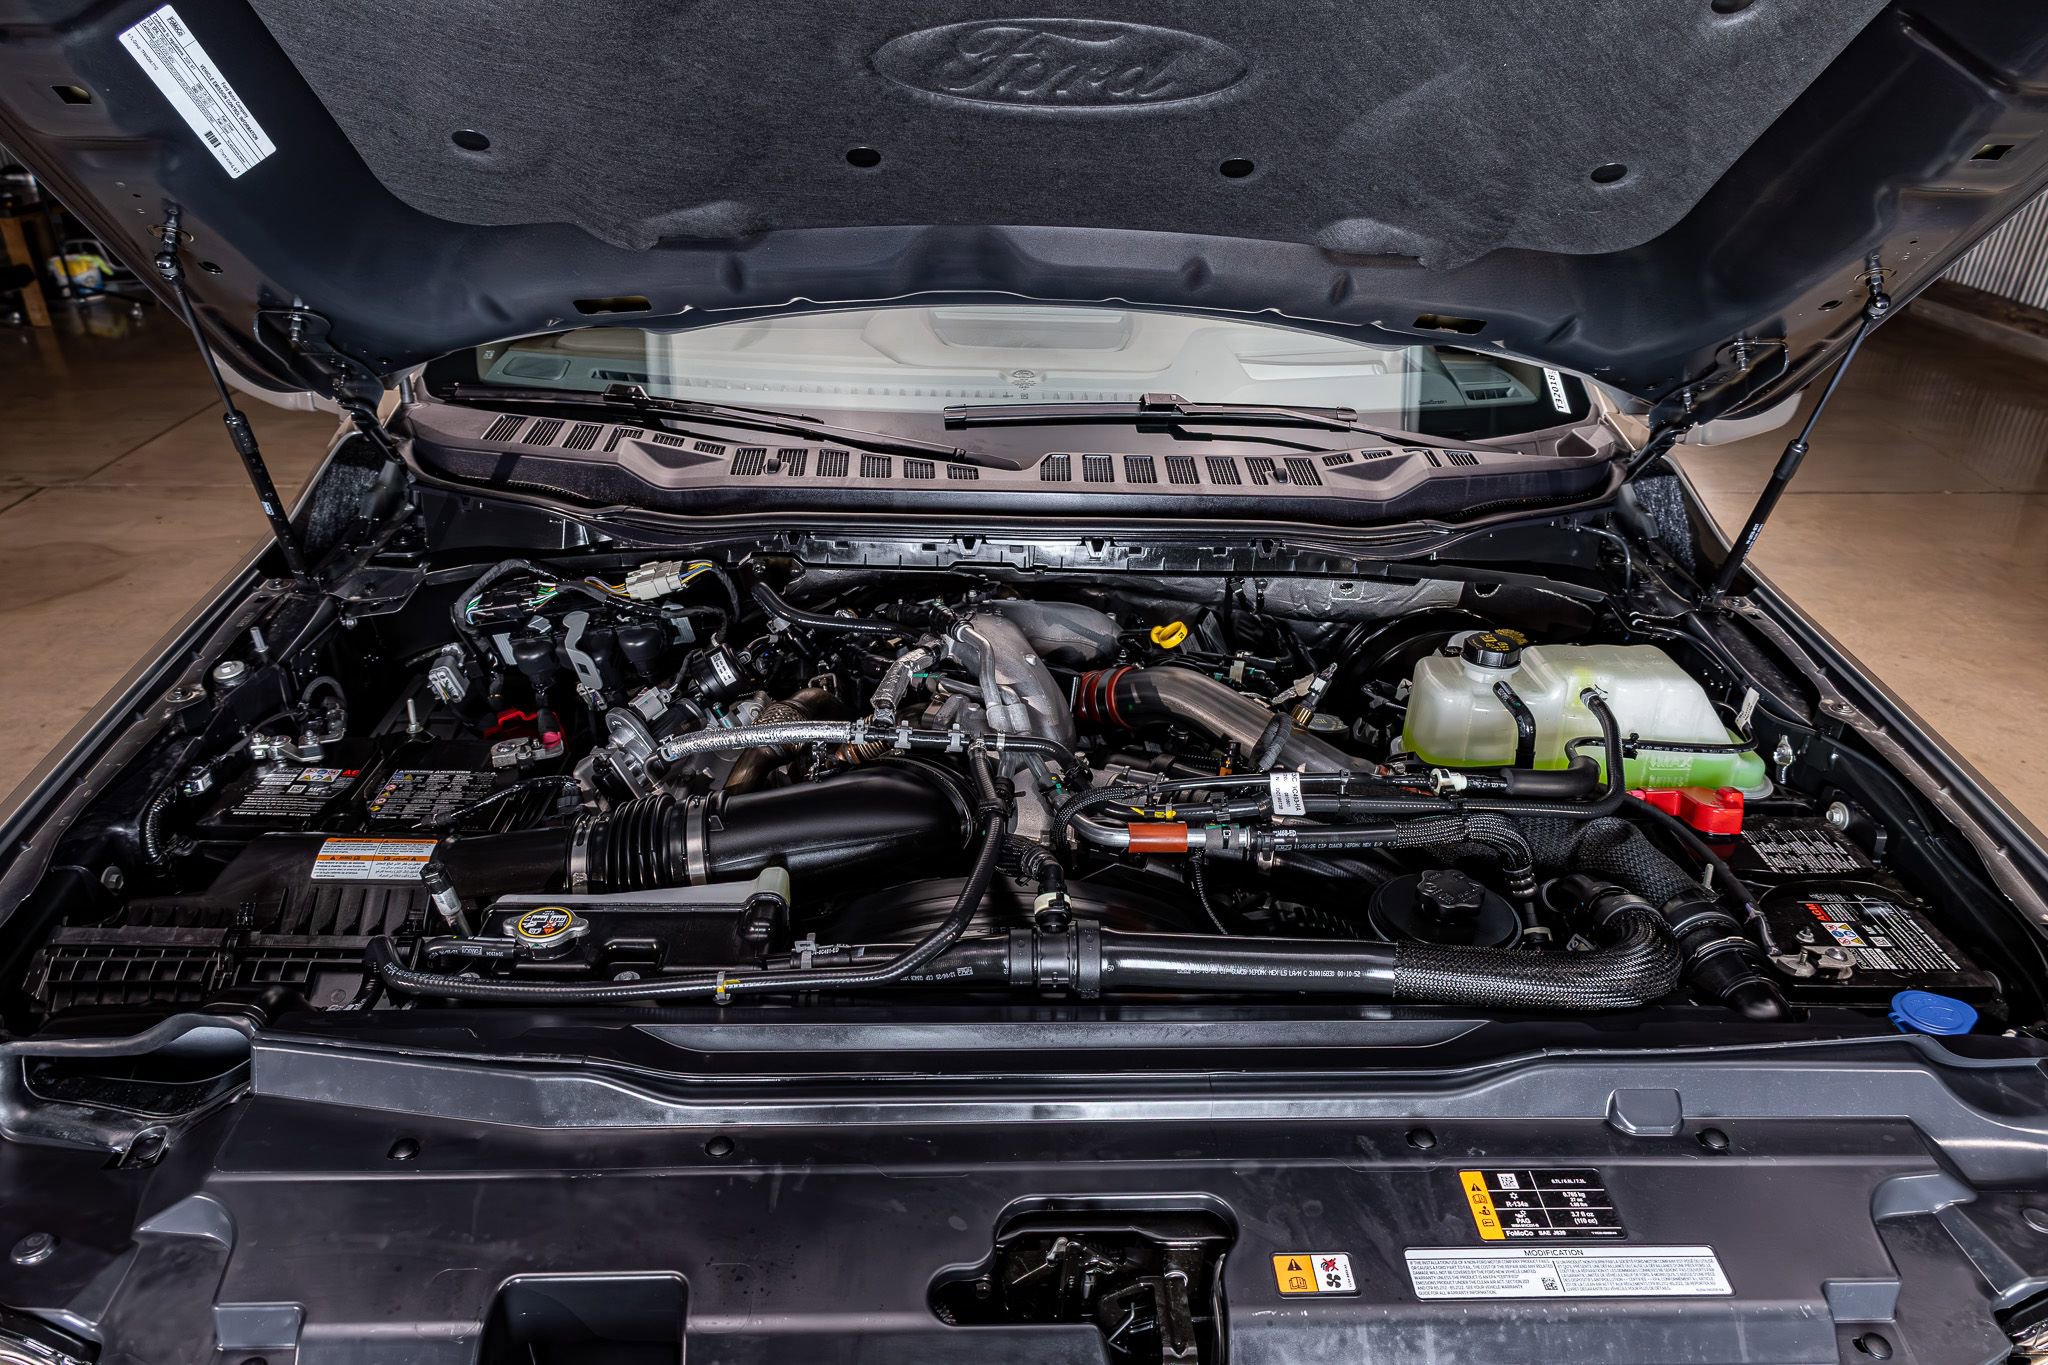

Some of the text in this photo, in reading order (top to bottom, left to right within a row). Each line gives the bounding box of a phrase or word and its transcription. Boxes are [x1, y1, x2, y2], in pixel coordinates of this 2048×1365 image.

[938, 26, 1187, 98] Ford
[199, 63, 258, 140] VEHICLE EMISSION CONTROL INFORMATION
[234, 100, 249, 118] Company
[1548, 374, 1564, 410] T32018
[1805, 904, 1826, 921] AGM
[1523, 1249, 1584, 1257] MODIFICATION
